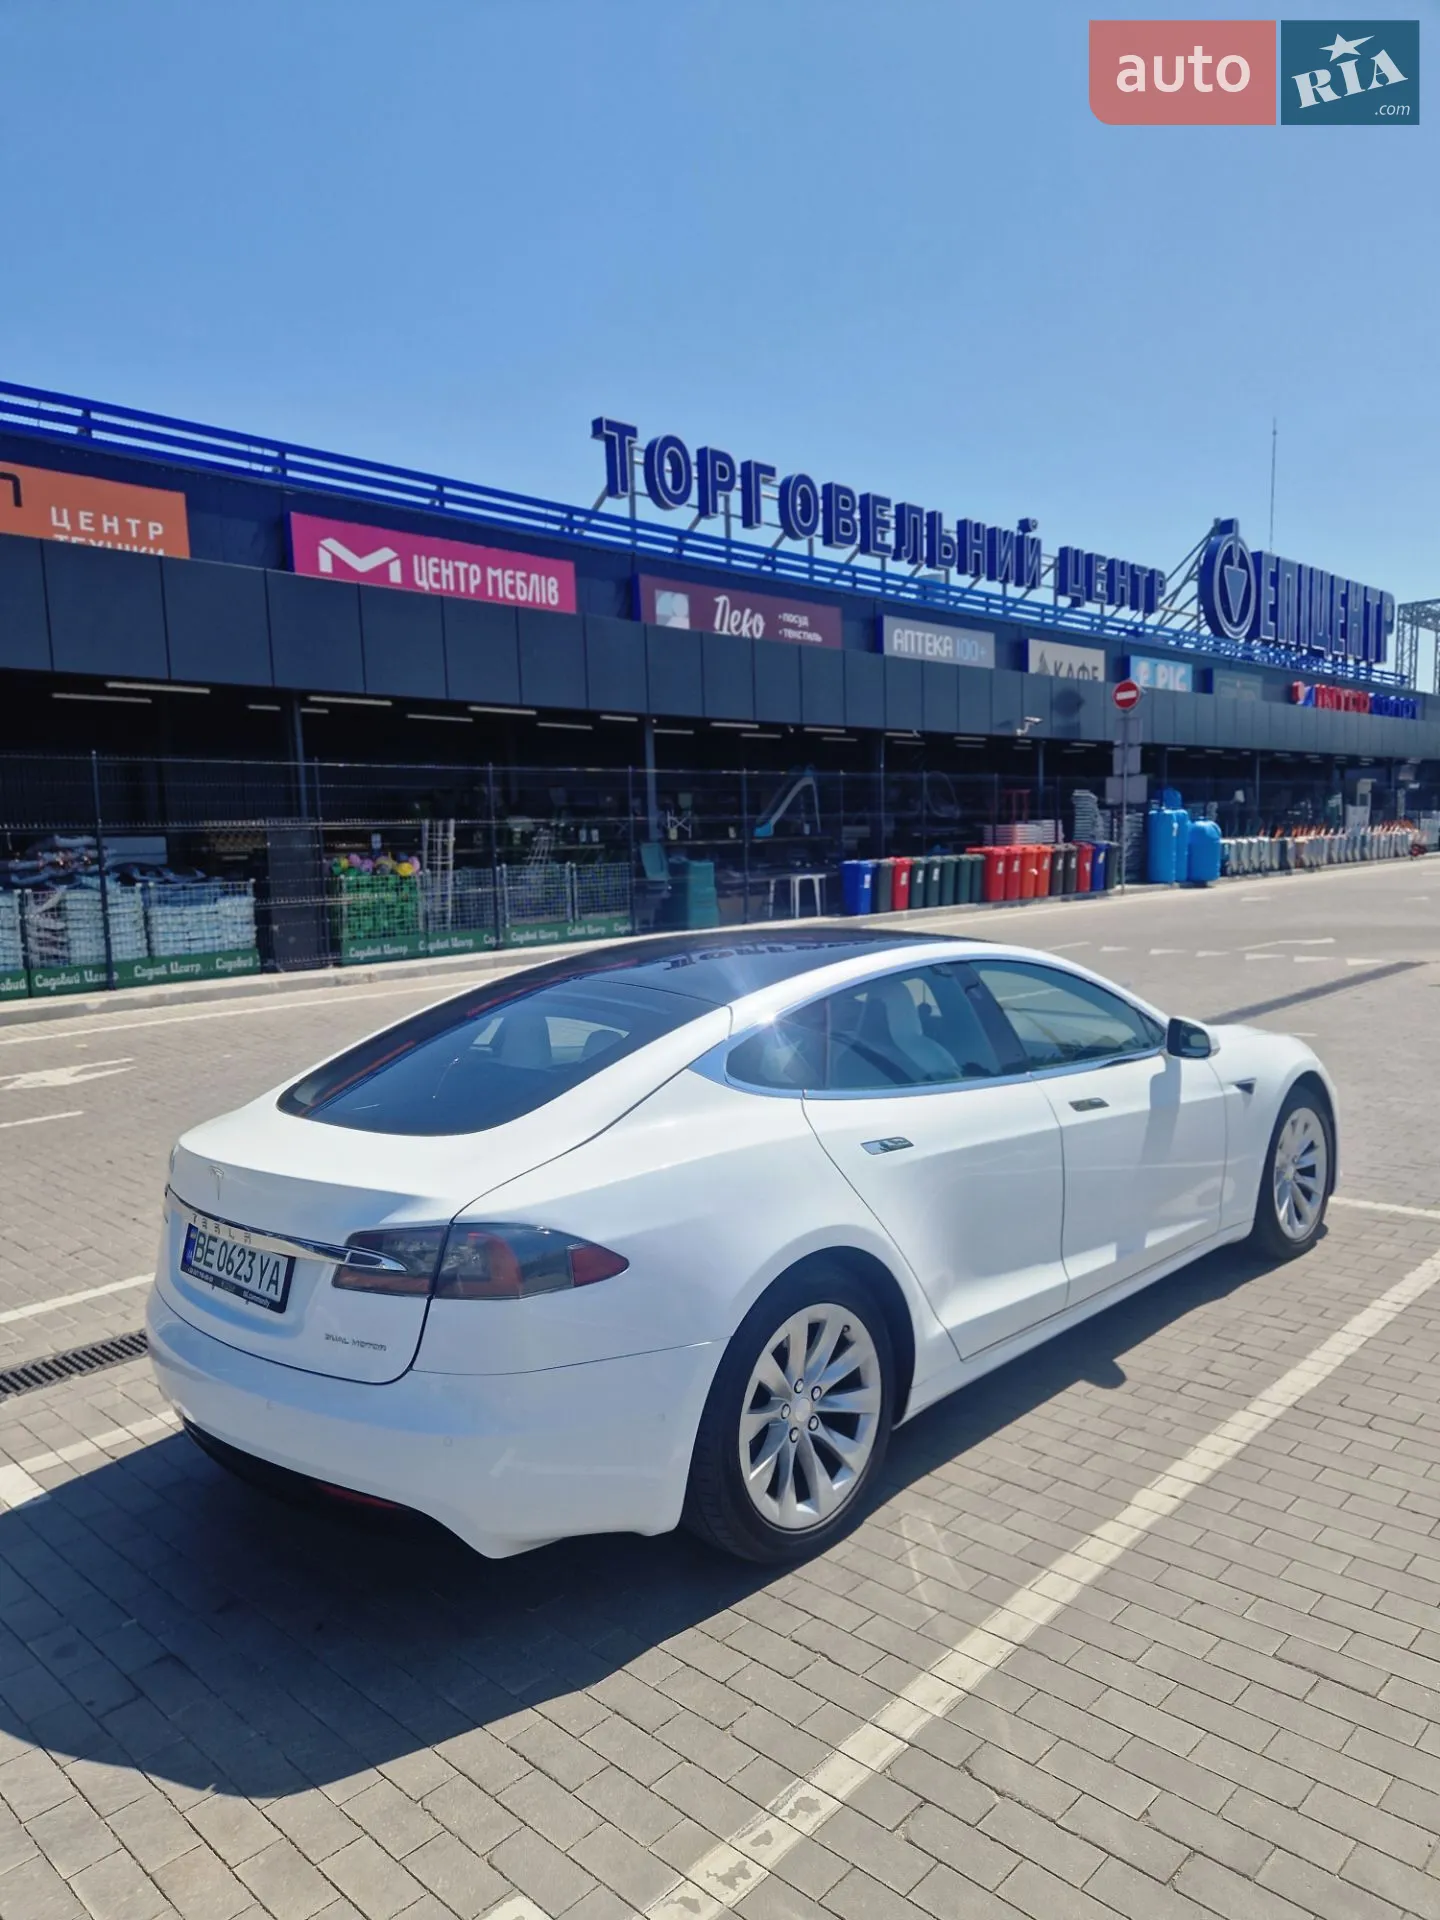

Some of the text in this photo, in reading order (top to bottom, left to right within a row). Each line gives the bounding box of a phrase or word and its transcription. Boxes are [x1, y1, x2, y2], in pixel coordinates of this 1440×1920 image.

[51, 506, 164, 540] ЦЕНТР
[591, 416, 1167, 614] ТОРГОВЕЛЬНИЙ ЦЕНТР
[413, 554, 559, 605] ЦЕНТР МЕБЛІВ
[1251, 550, 1396, 664] ЕПІЦЕНТР
[893, 628, 953, 656] АПТЕКА
[1054, 659, 1100, 681] КАФЕ
